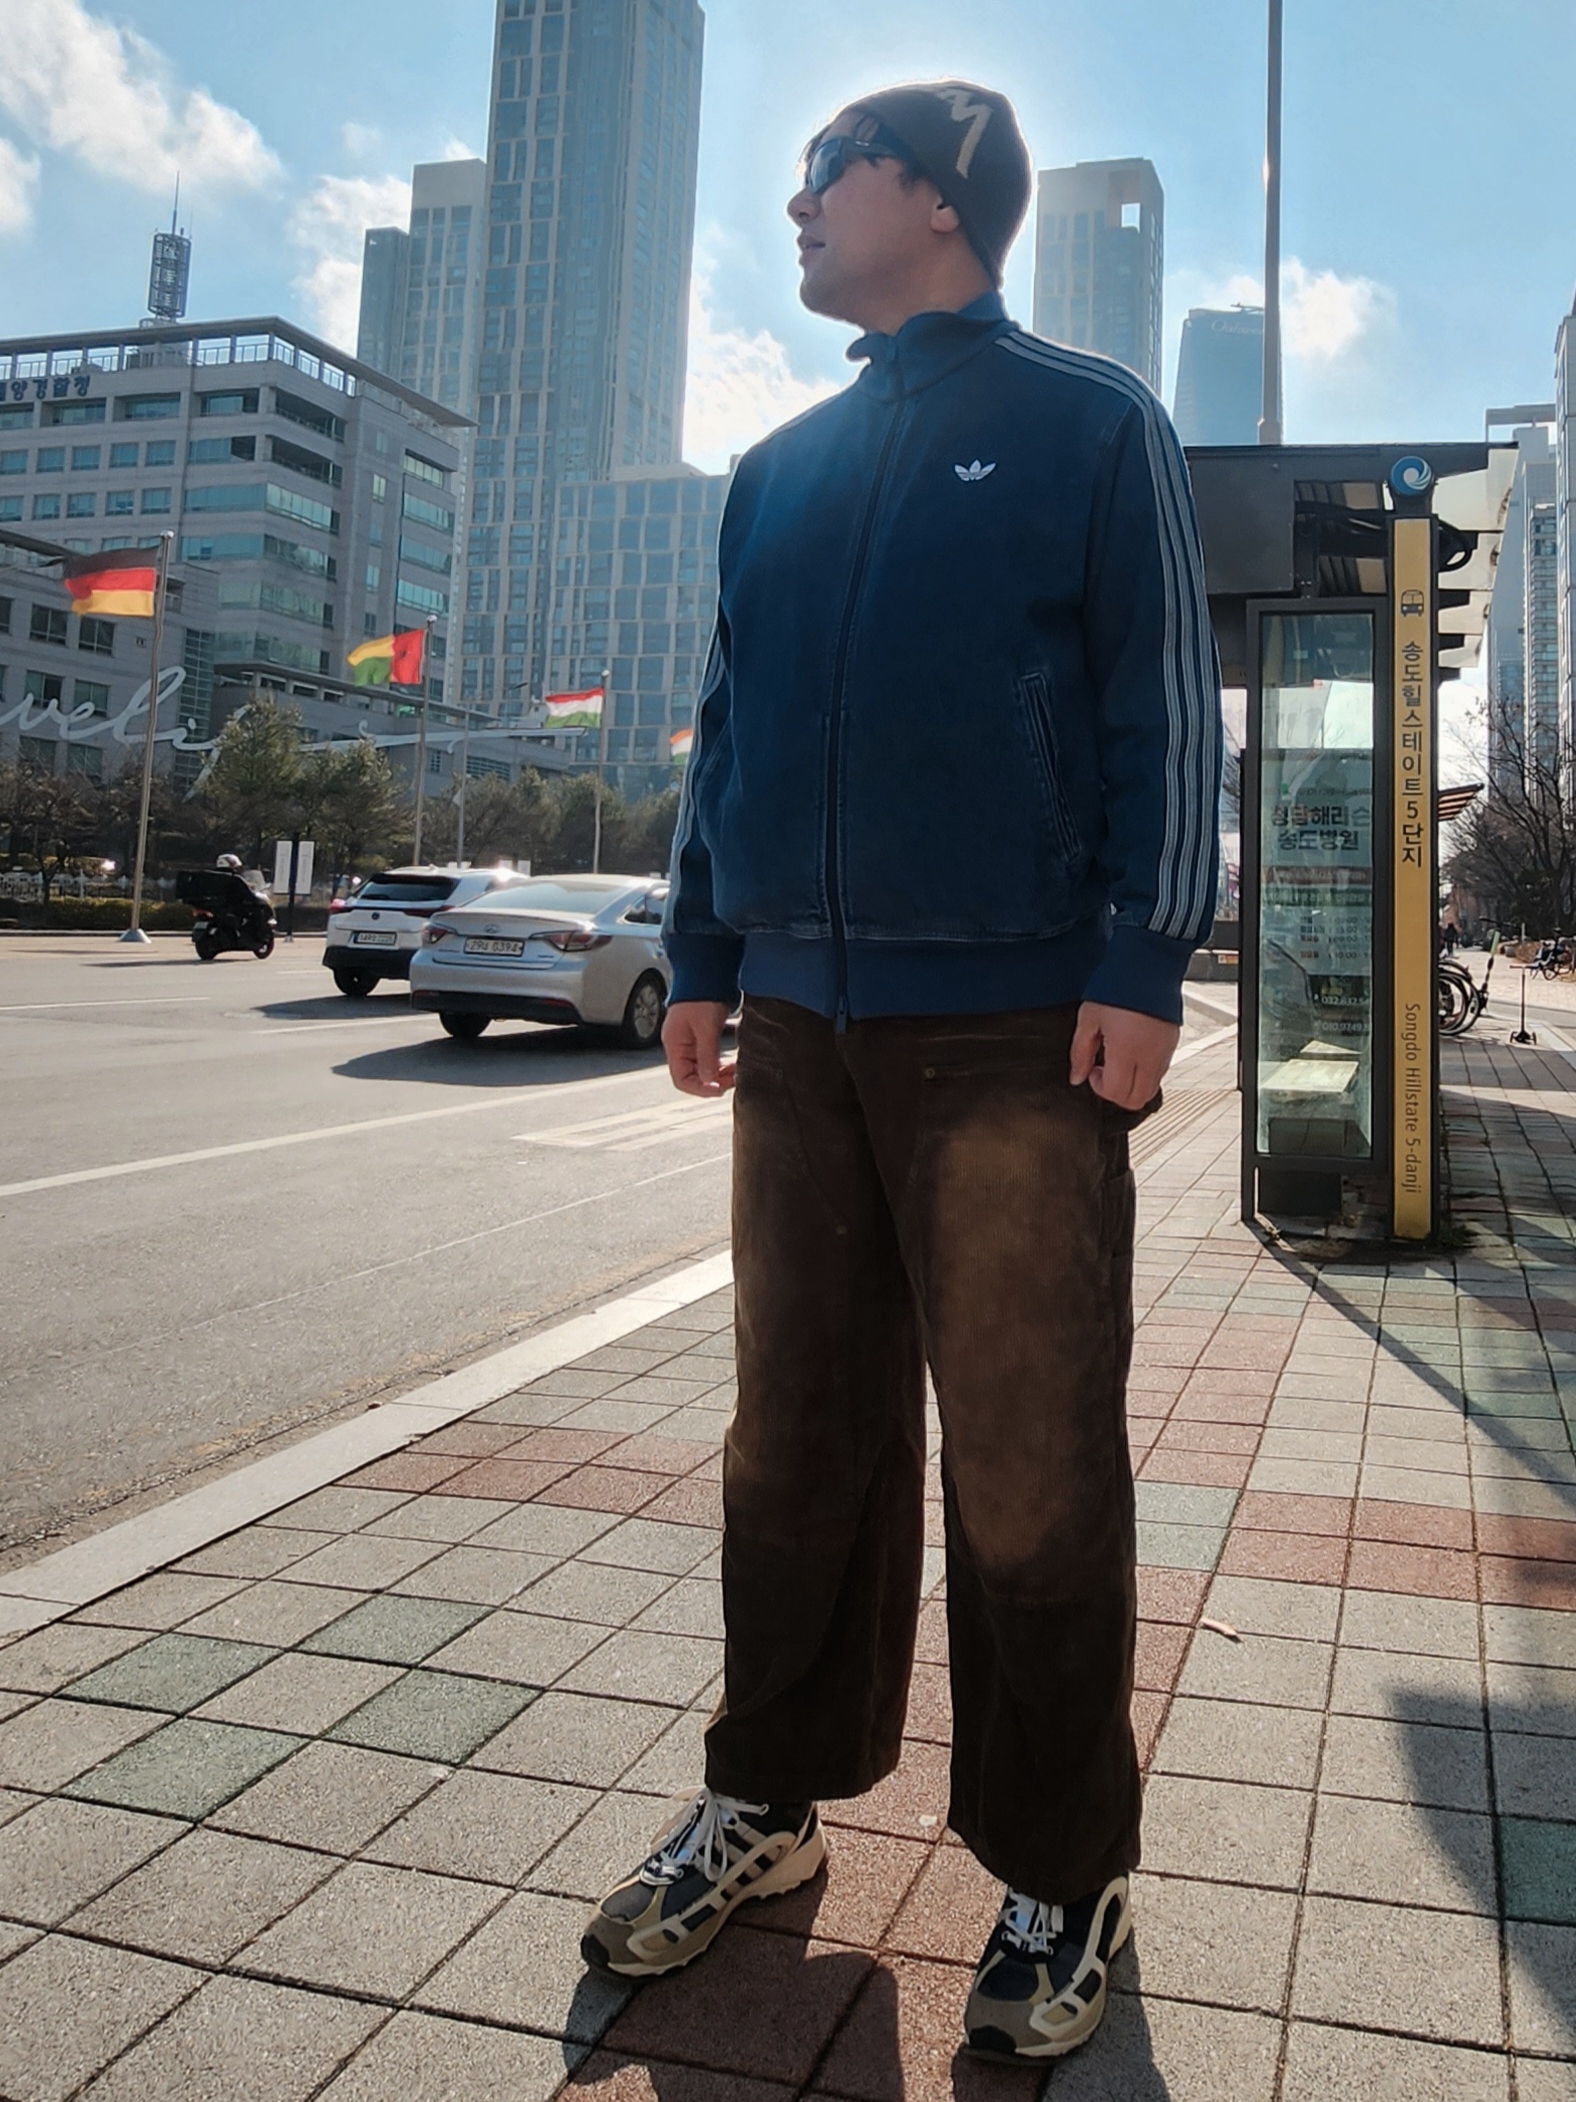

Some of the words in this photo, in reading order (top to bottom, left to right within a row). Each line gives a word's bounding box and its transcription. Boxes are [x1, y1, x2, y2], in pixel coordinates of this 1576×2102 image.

[1401, 1003, 1421, 1061] Songdo
[1405, 1068, 1421, 1132] Hillstate
[1401, 1138, 1421, 1194] 5-danji
